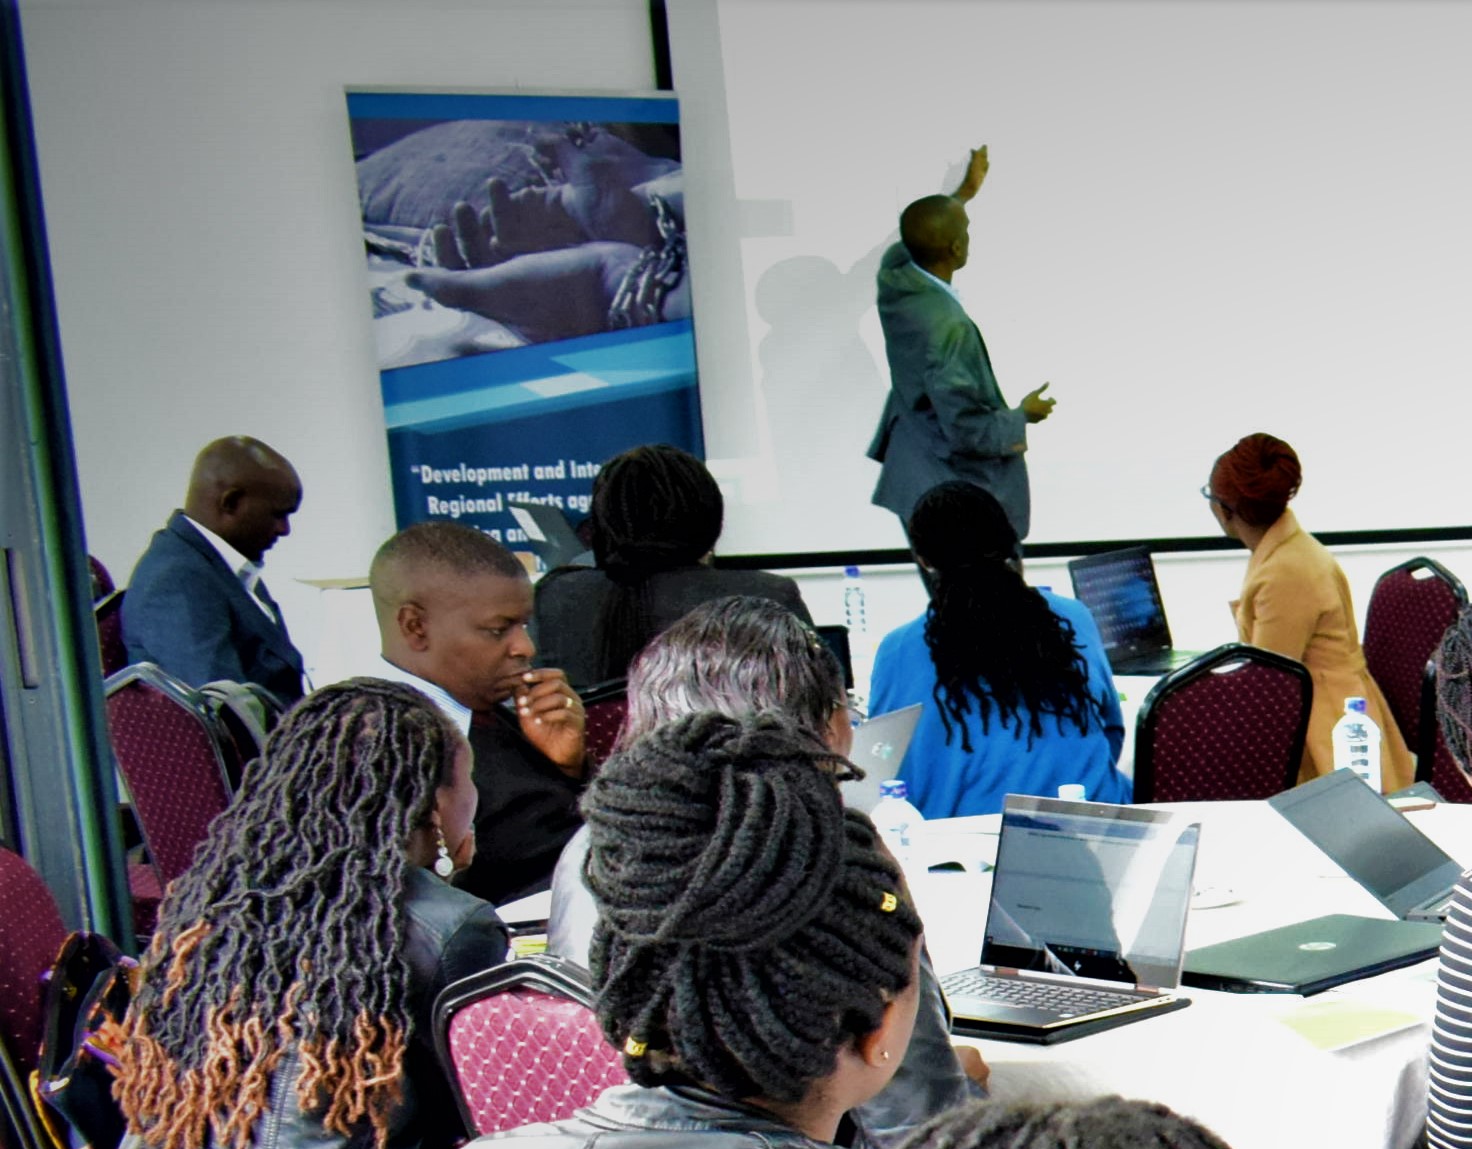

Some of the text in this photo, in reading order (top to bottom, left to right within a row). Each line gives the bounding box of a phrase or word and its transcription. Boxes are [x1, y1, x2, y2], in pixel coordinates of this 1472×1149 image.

[533, 459, 565, 480] and
[427, 492, 503, 518] Regional
[567, 494, 592, 513] ag
